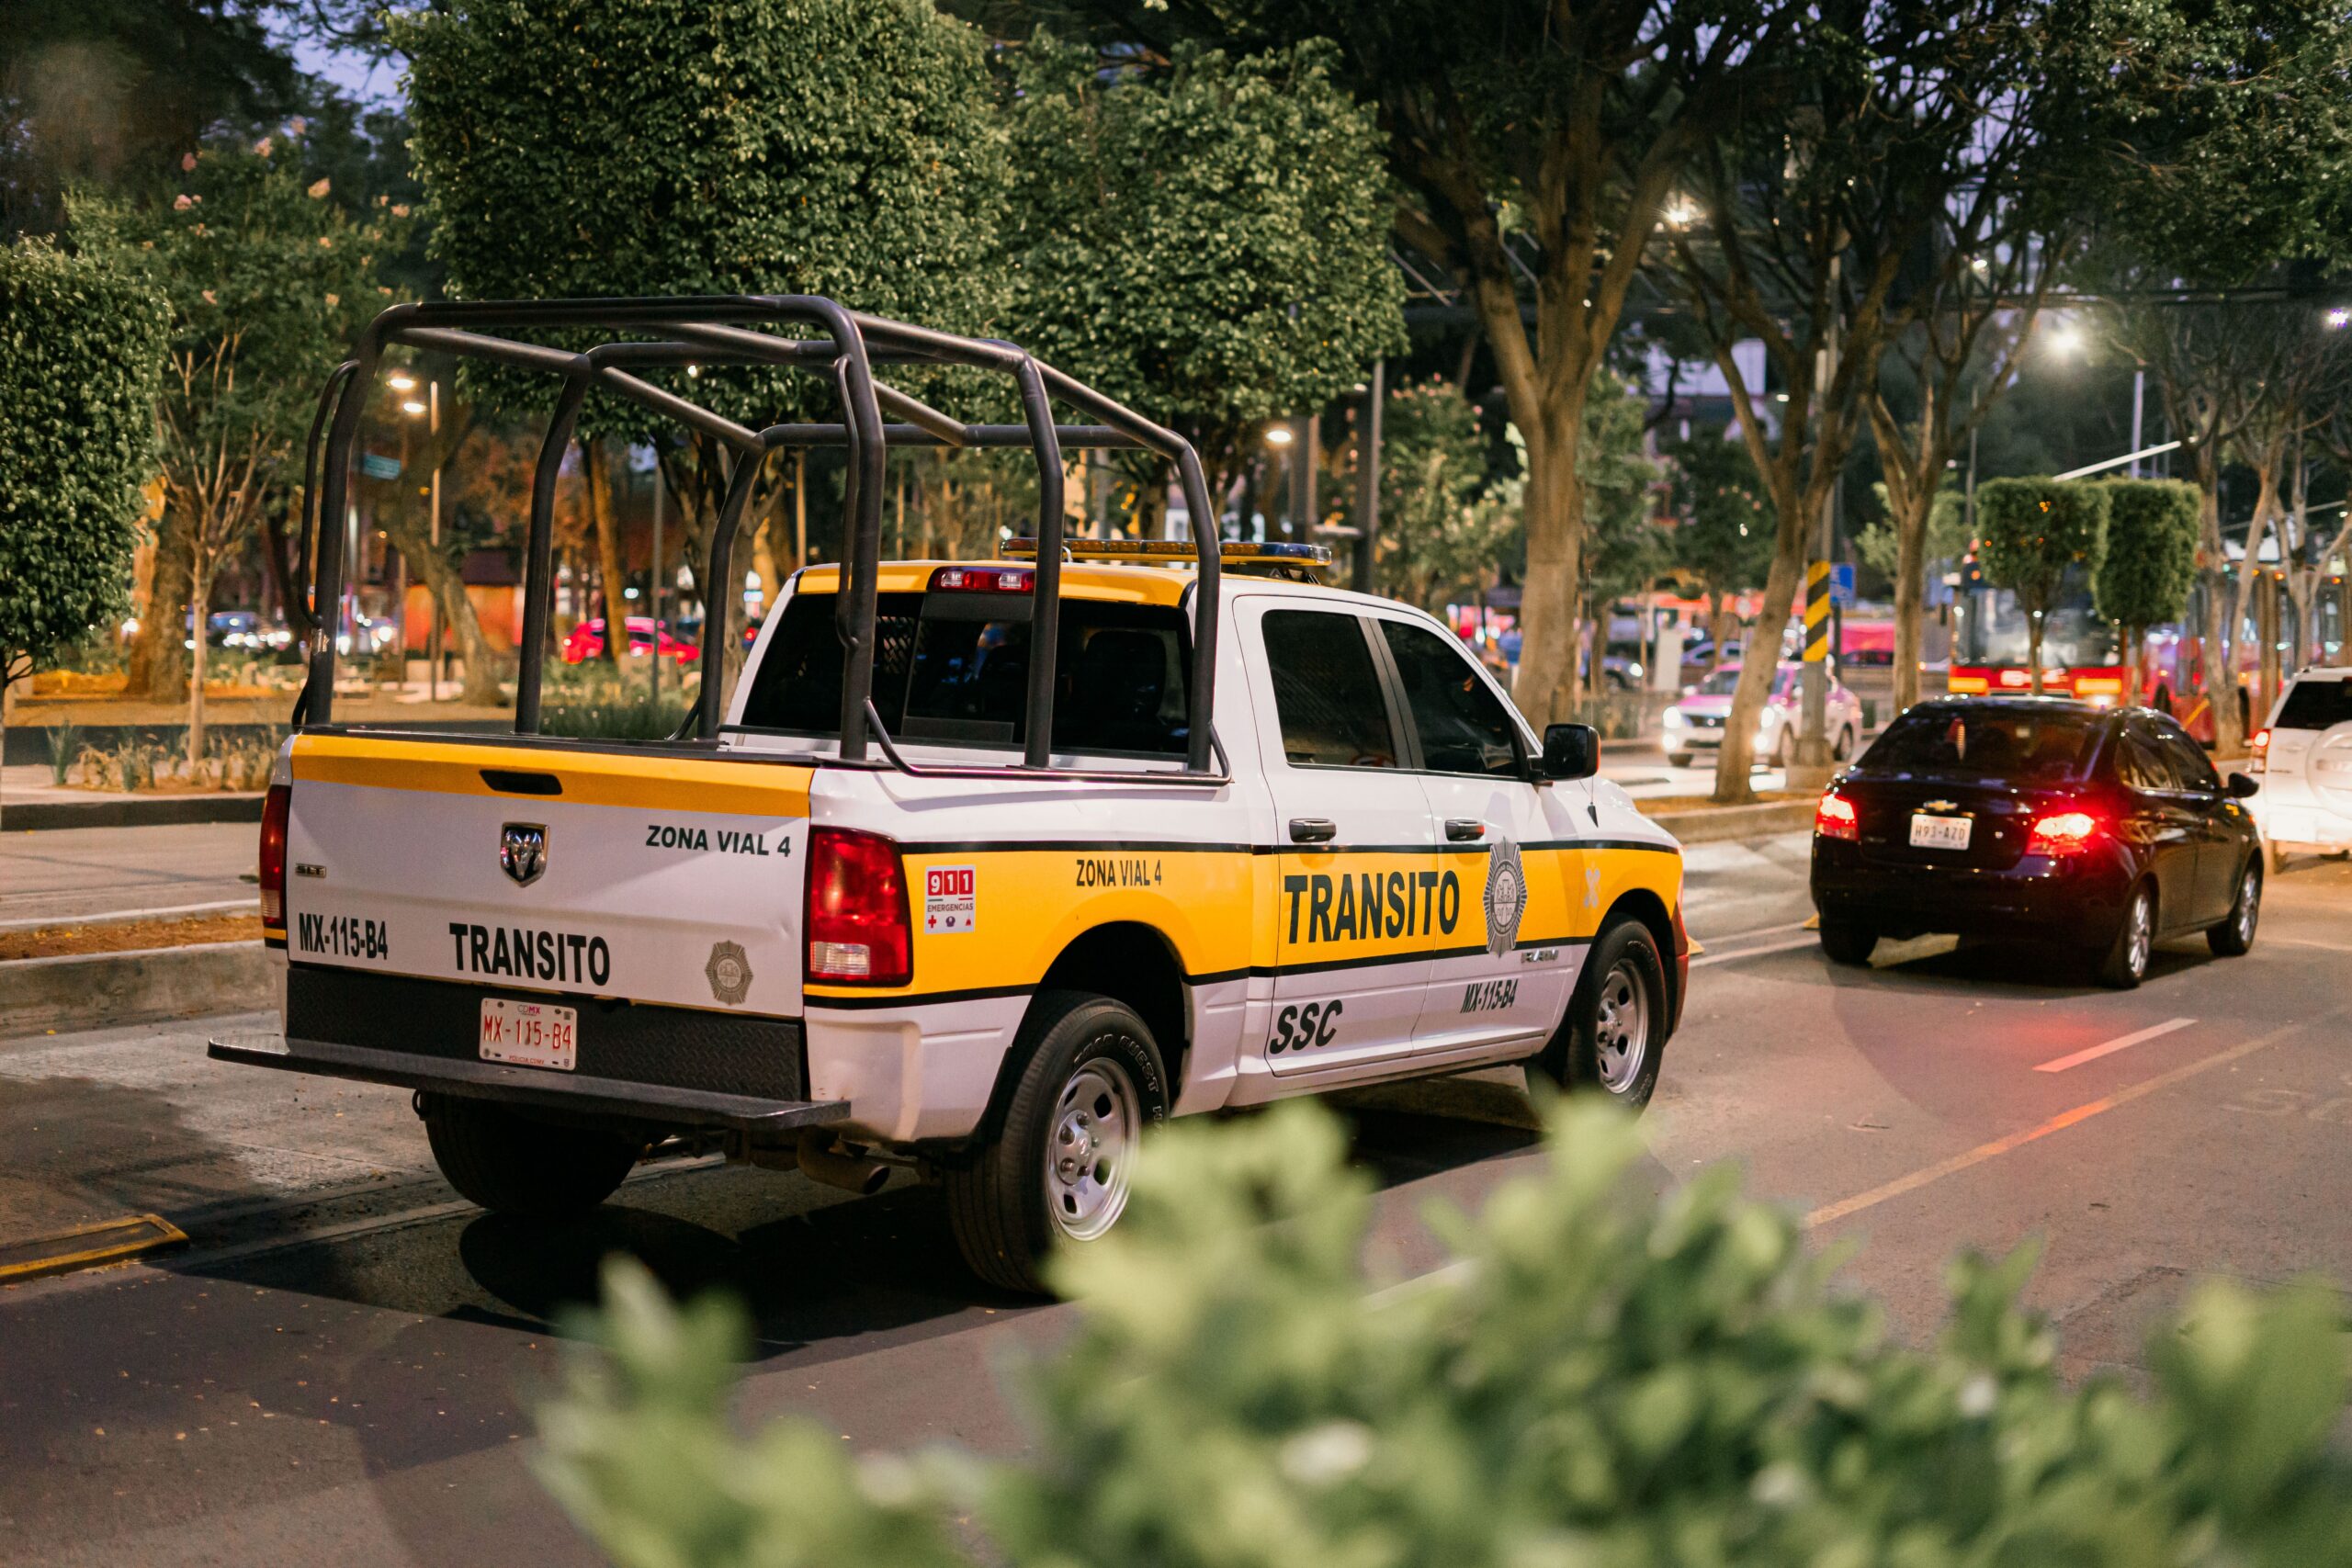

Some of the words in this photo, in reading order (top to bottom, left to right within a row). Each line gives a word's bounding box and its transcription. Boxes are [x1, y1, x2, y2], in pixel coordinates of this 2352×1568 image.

[646, 825, 708, 851] ZONA
[718, 830, 769, 856] VIAL
[777, 836, 790, 857] 4
[930, 874, 969, 893] 911
[1076, 859, 1116, 886] ZONA
[1120, 859, 1150, 886] VIAL
[1155, 859, 1161, 886] 4
[927, 903, 973, 912] EMERGENCIAS
[1283, 870, 1460, 944] TRANSITO
[299, 912, 388, 961] MX-115-B4
[449, 922, 610, 986] TRANSITO
[517, 1004, 540, 1015] CDMX
[1460, 978, 1519, 1014] MX-115-B4
[484, 1014, 571, 1050] MX-115-B4
[1269, 999, 1343, 1055] SSC
